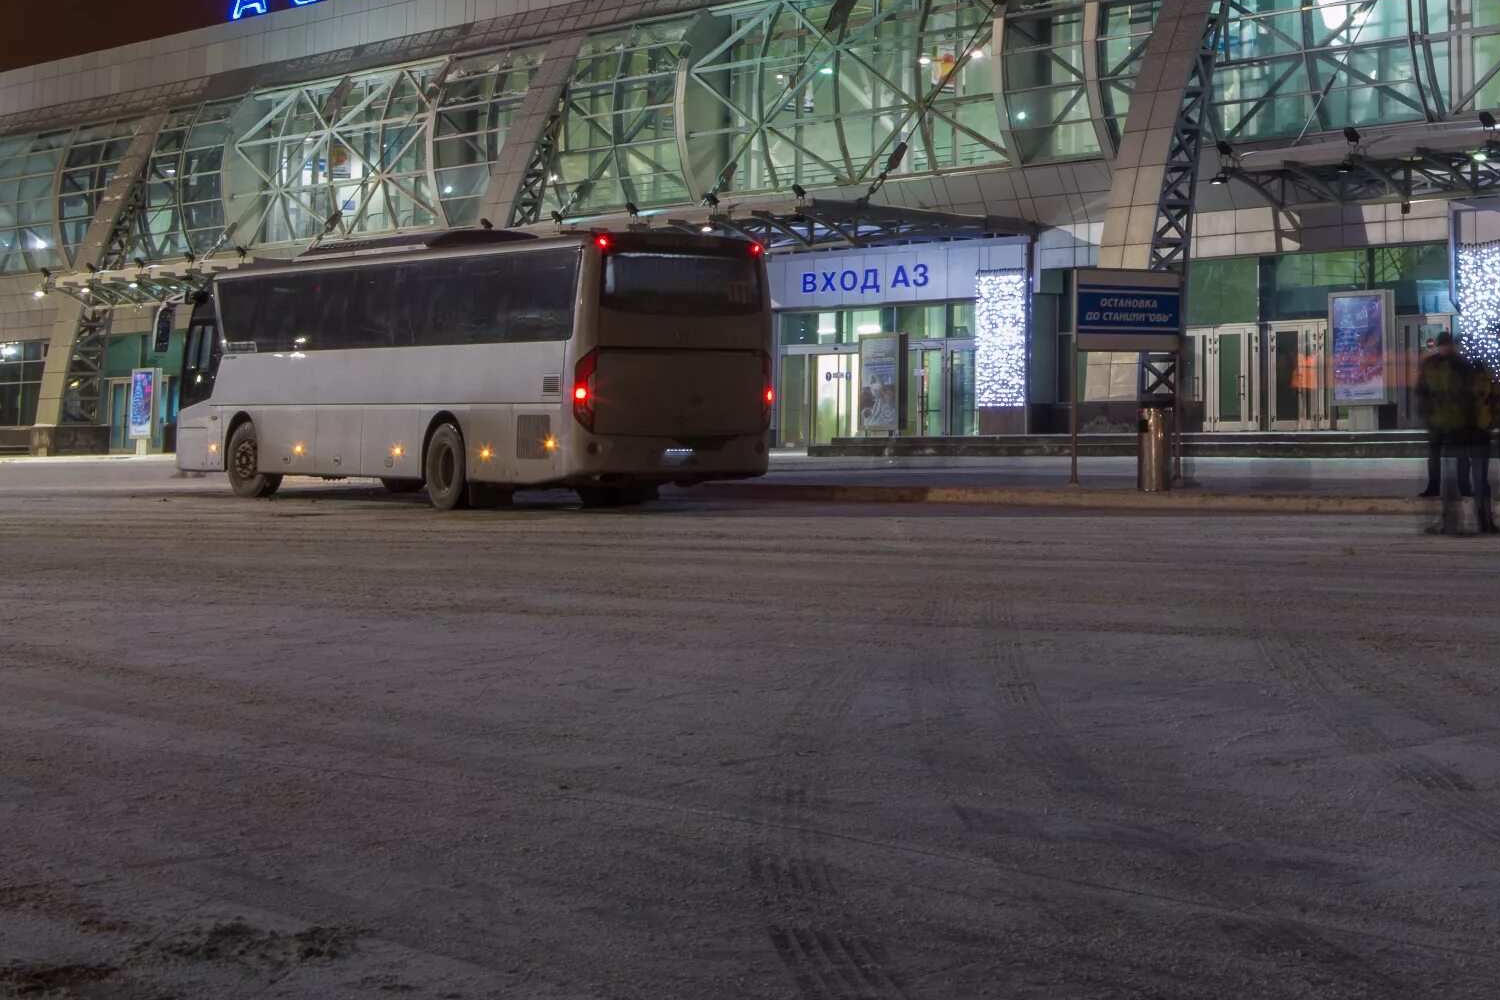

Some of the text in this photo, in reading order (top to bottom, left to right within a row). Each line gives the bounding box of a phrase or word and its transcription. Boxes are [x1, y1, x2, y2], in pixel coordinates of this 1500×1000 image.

[801, 269, 881, 294] ВХОД
[1100, 298, 1158, 309] ОСТАНОВКА
[1085, 311, 1100, 321] ДО
[1102, 312, 1146, 322] СТАНЦИИ
